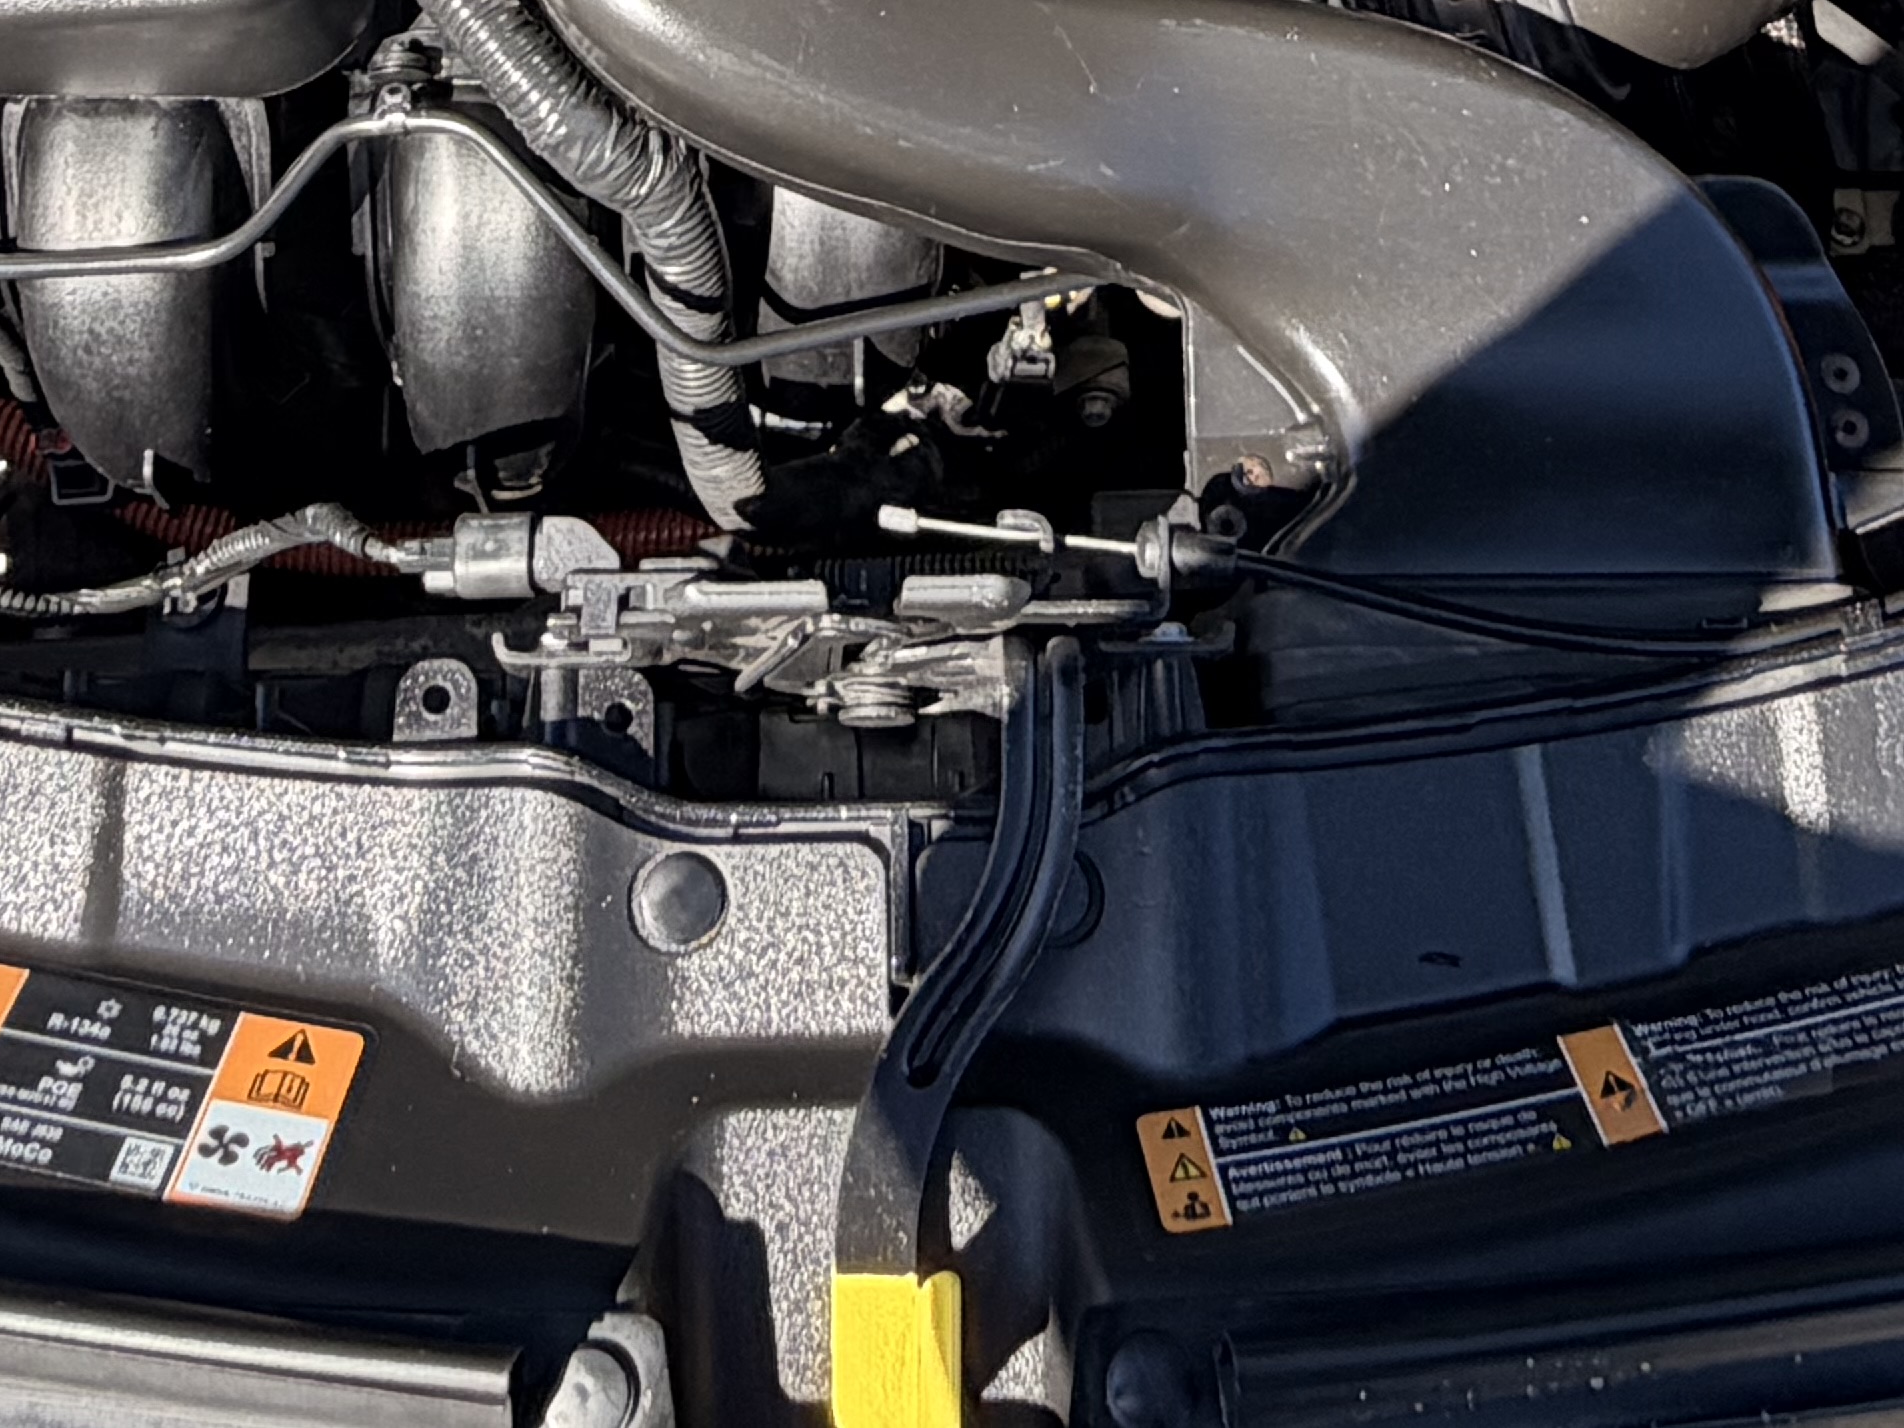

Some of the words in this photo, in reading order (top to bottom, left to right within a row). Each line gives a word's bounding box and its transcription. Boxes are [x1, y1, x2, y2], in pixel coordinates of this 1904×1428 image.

[1726, 997, 1776, 1016] reduce
[1777, 990, 1802, 1002] the
[47, 1012, 111, 1039] R-134a
[37, 1076, 82, 1100] POE
[1209, 1100, 1279, 1120] Warning:
[1284, 1094, 1302, 1107] To
[1305, 1086, 1356, 1104] reduce
[1358, 1080, 1383, 1093] the
[1416, 1068, 1431, 1081] of
[1228, 1148, 1342, 1180] Avertissement
